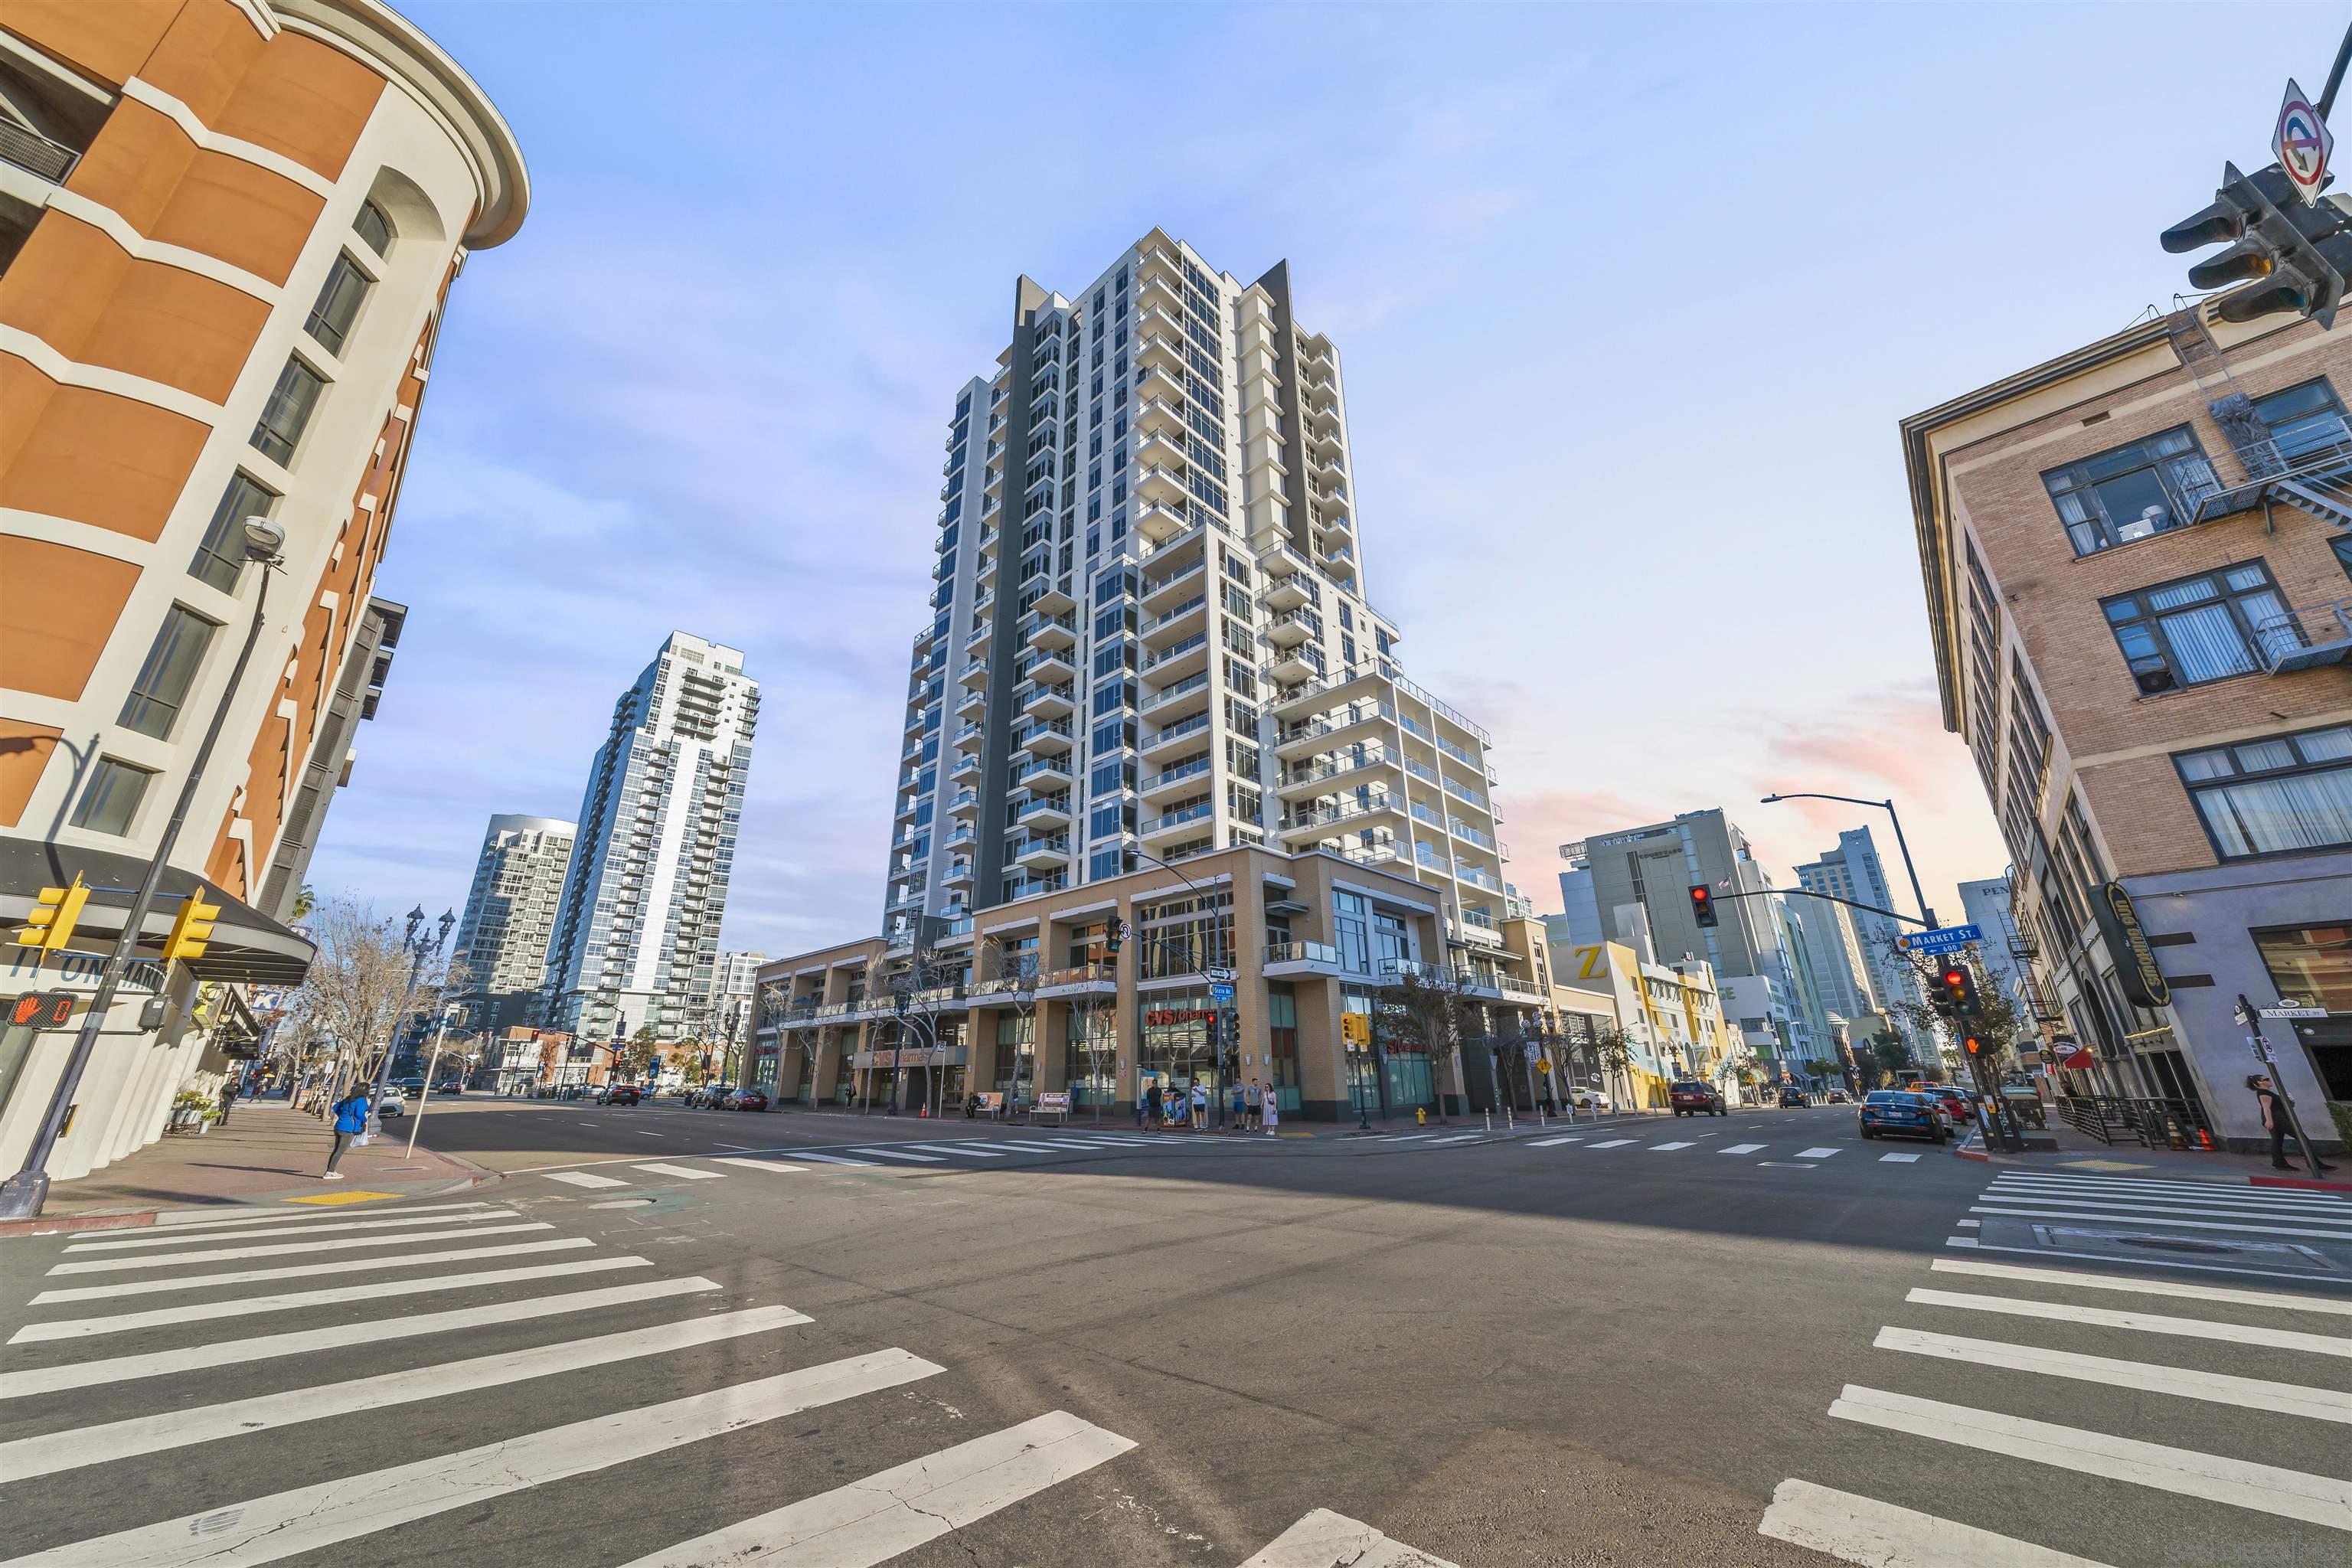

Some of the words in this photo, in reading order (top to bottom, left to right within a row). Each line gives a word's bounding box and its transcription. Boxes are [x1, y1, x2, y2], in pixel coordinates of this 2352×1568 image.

[1911, 933, 1955, 947] MARKET
[1958, 929, 1977, 939] ST.
[1942, 944, 1958, 952] 600
[1575, 946, 1607, 980] Z
